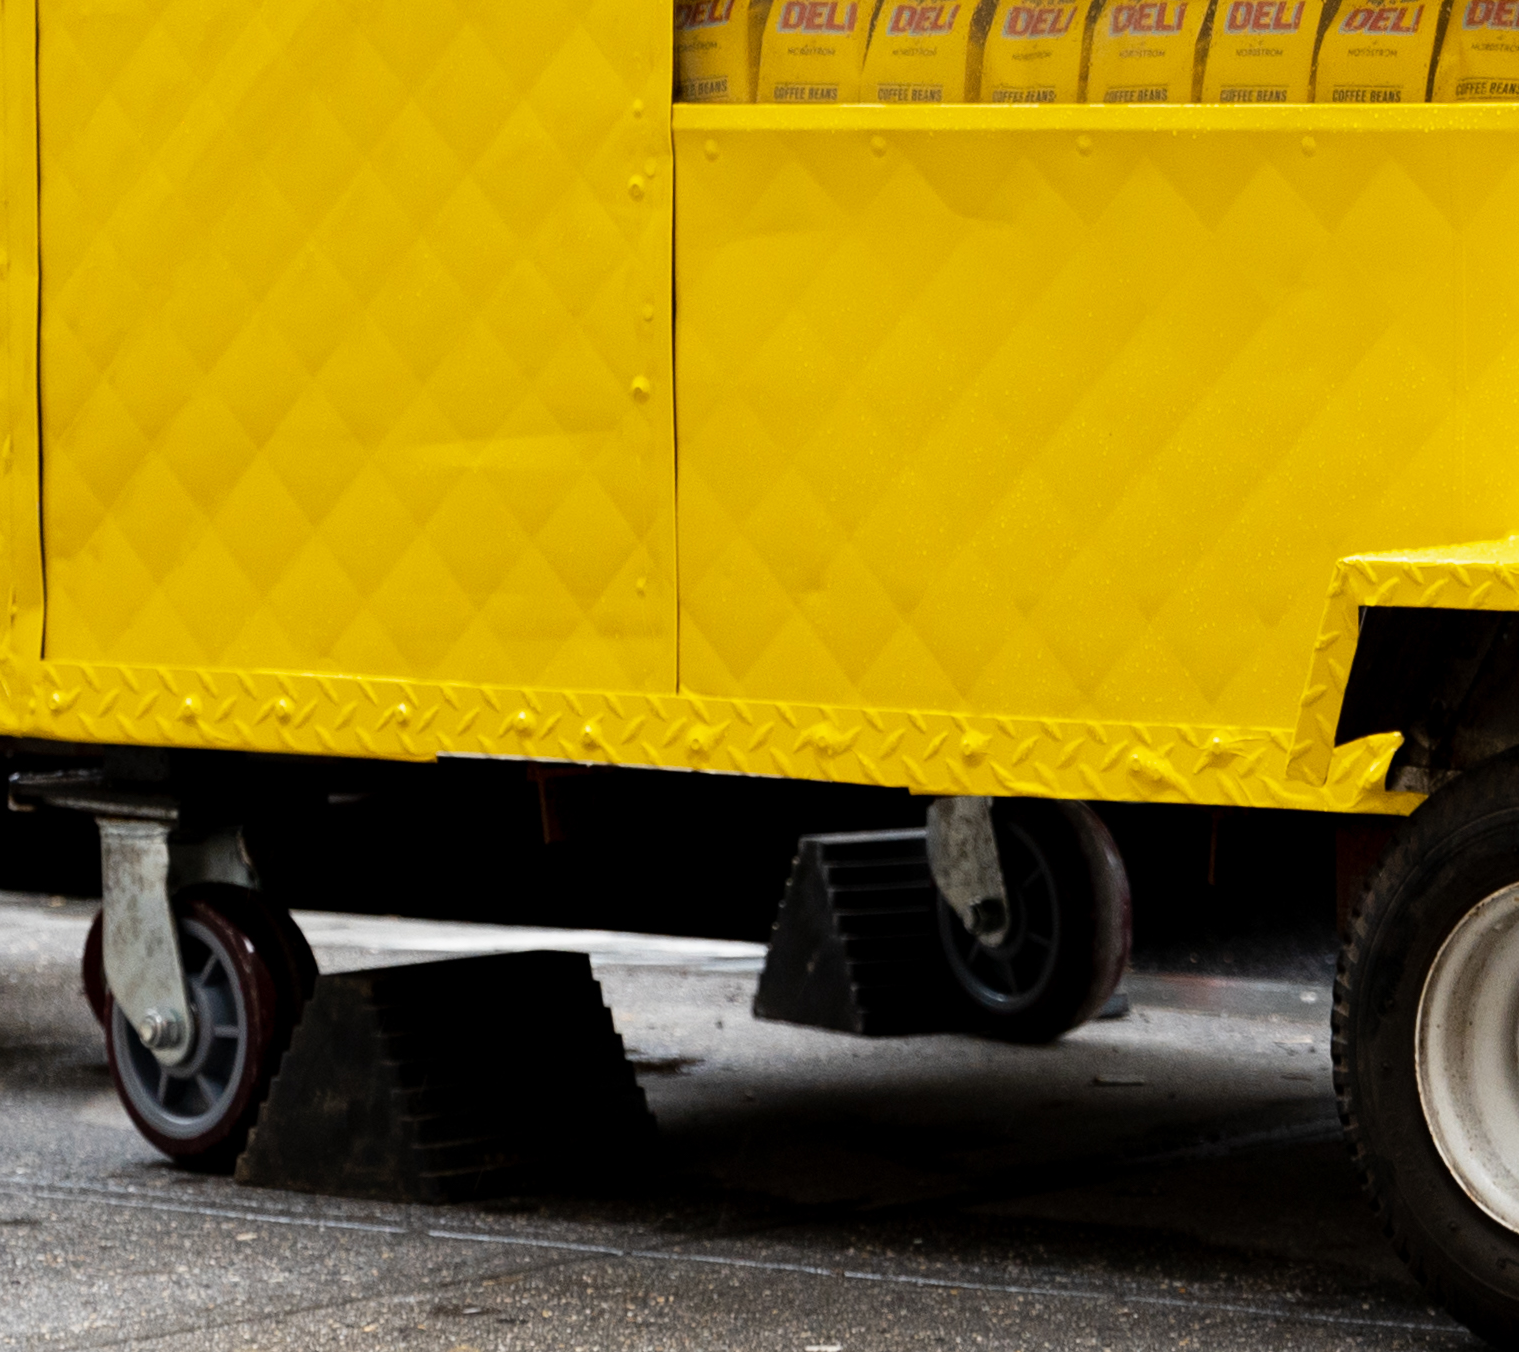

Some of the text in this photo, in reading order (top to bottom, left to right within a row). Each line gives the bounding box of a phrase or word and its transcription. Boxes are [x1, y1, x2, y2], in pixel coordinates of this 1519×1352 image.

[777, 0, 858, 36] DELI
[886, 4, 961, 36] DELI
[1001, 6, 1078, 40] DELI
[1109, 1, 1188, 37] DELI
[1224, 0, 1305, 36] DELI
[1338, 4, 1425, 36] DELI
[773, 86, 838, 100] COFFEE BEANS
[1220, 89, 1287, 103] COFFEE BEANS
[1332, 89, 1401, 103] COFFEE BEANS
[1456, 83, 1486, 95] COFFEE
